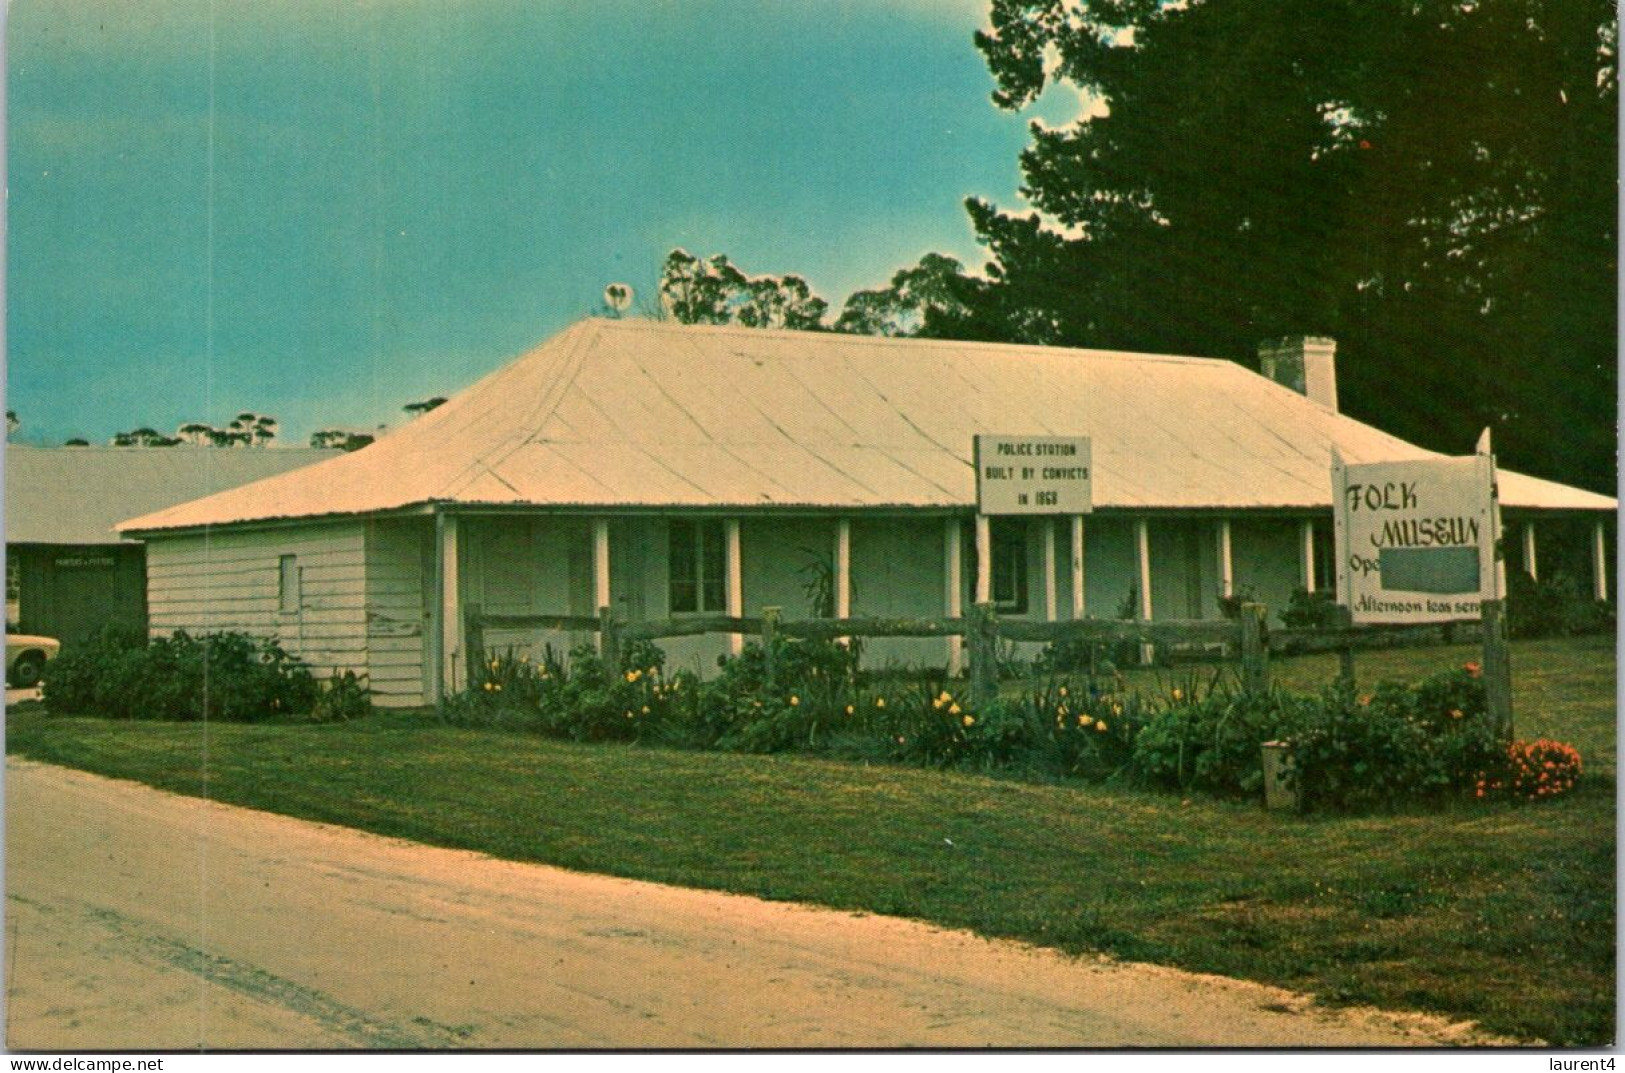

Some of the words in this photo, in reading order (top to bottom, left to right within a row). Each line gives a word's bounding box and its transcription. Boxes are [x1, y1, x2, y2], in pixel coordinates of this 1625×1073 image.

[997, 443, 1032, 456] POLICE
[1035, 443, 1076, 456] STATION
[986, 467, 1014, 480] BUILT
[1022, 467, 1035, 480] BY
[1042, 467, 1088, 480] CONVICTS
[1018, 493, 1028, 505] IN
[1035, 491, 1058, 506] 1868
[1346, 482, 1417, 511] FOLK
[1354, 594, 1422, 613] Afternoon
[1427, 599, 1452, 613] teas
